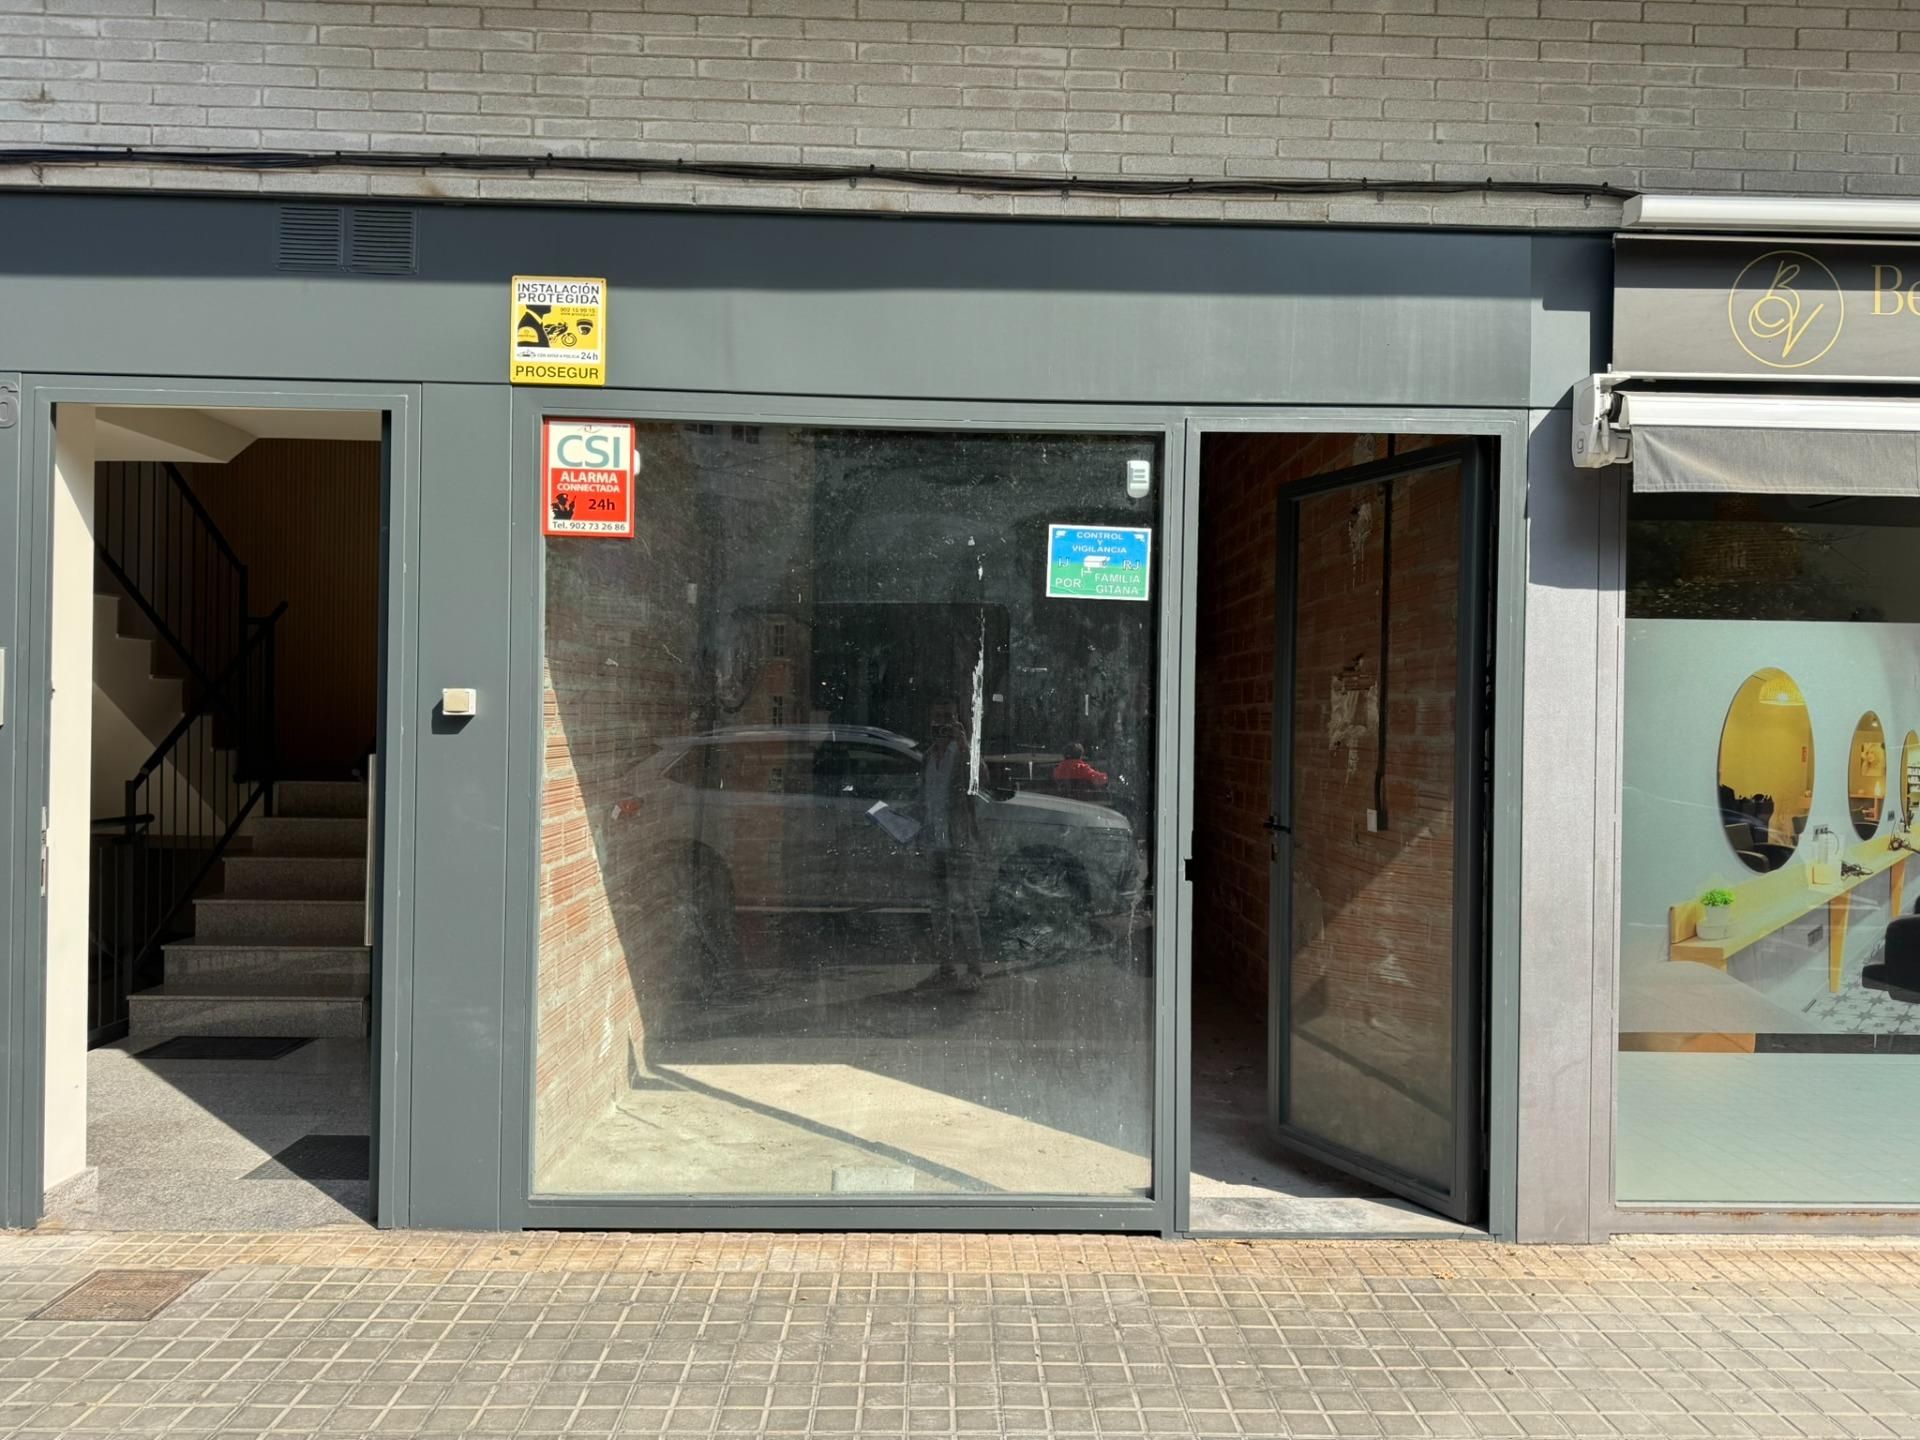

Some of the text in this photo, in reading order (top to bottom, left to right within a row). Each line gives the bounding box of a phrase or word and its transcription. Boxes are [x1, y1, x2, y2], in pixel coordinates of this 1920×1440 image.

[517, 282, 600, 295] INSTALACIÓN
[517, 292, 599, 305] PROTEGIDA
[515, 365, 599, 379] PROSEGUR
[557, 434, 620, 468] CSI
[560, 471, 618, 483] ALARMA
[557, 482, 620, 493] CONNECTADA
[588, 498, 616, 511] 24h
[552, 521, 626, 531] Tel. 902 73 26 86
[1076, 531, 1124, 540] CONTROL
[1072, 545, 1127, 553] VIGILANCIA
[1055, 578, 1081, 588] POR
[1094, 573, 1140, 583] FAMILIA
[1095, 584, 1139, 595] GITANA
